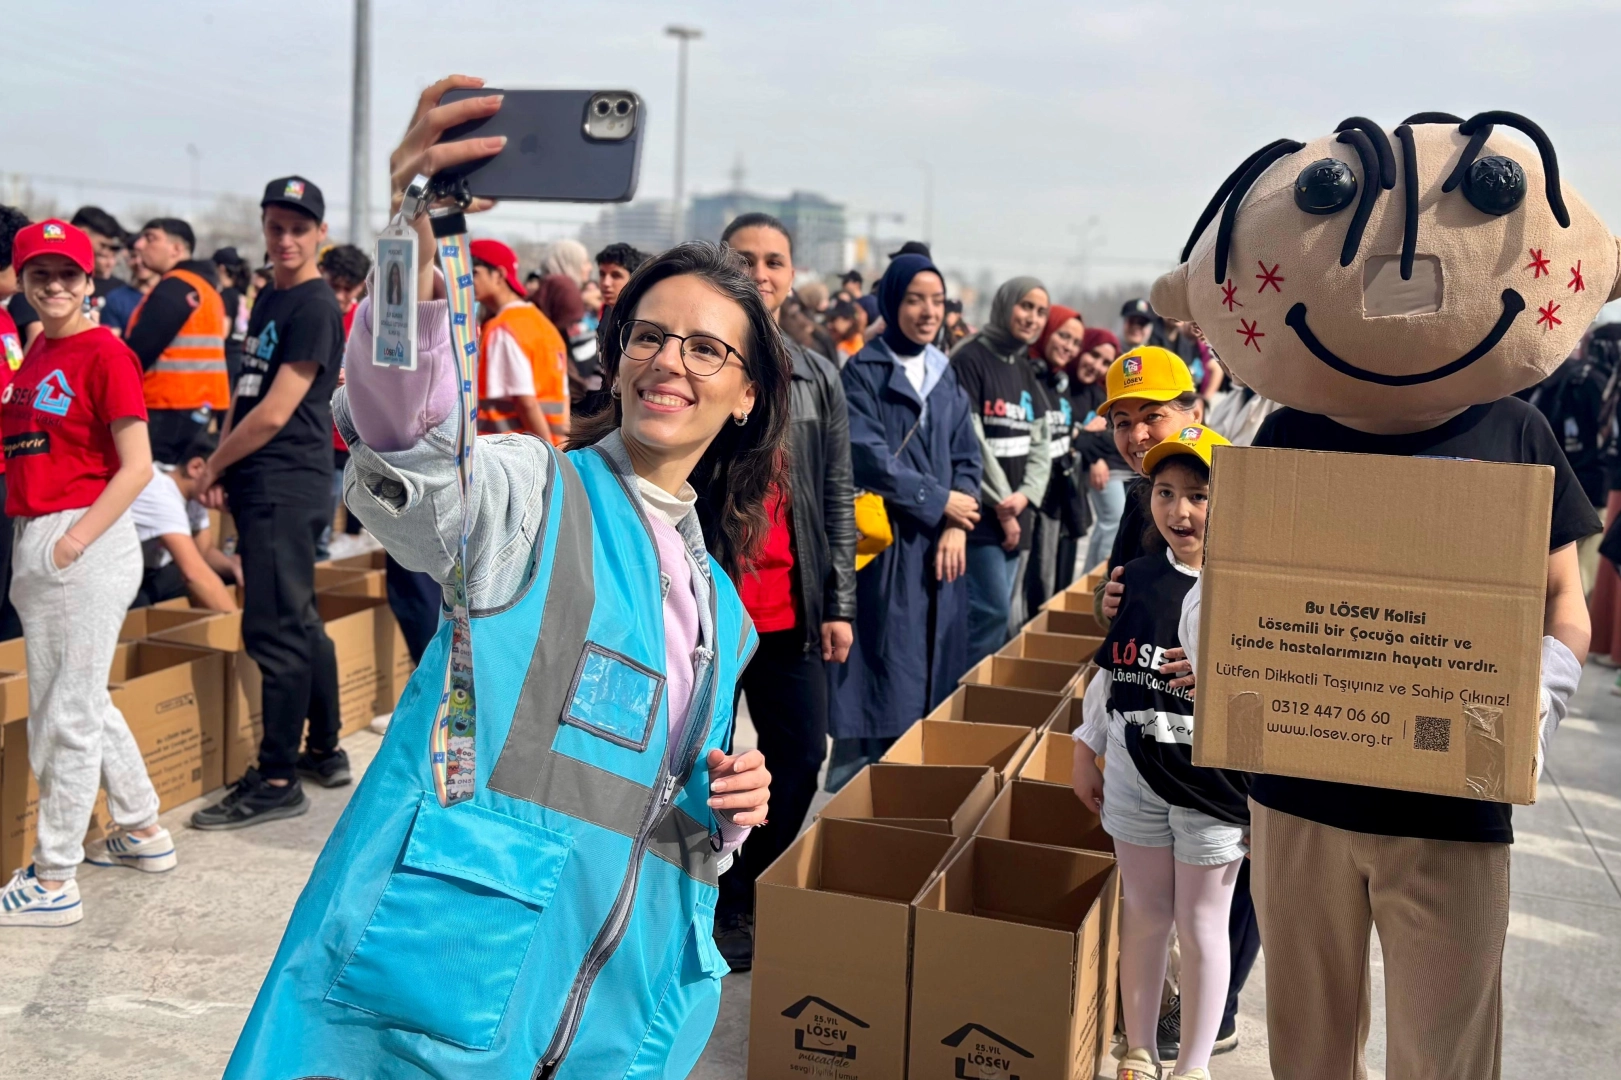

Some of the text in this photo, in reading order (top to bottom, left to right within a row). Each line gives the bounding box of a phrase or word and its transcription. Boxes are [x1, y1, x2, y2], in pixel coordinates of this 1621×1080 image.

[1, 383, 36, 406] ÖSEV
[1305, 601, 1426, 625] Bu LÖSEV Kolisi
[1258, 616, 1472, 650] Lösemili bir Çocuğa aittir ve
[1231, 633, 1498, 673] içinde hastalarımızın hayatı vardır.
[1145, 673, 1194, 702] Çocukla
[1216, 662, 1510, 706] Lütfen Dikkatli Taşıyınız ve Sahip Çıkınız!
[1272, 699, 1390, 725] 0312 447 06 60
[1267, 723, 1393, 747] www.losev.org.tr
[806, 1023, 847, 1040] LÖSEV
[814, 1014, 838, 1025] 25.YIL
[968, 1052, 1010, 1070] LÖSEV
[976, 1044, 1000, 1054] 25.YIL
